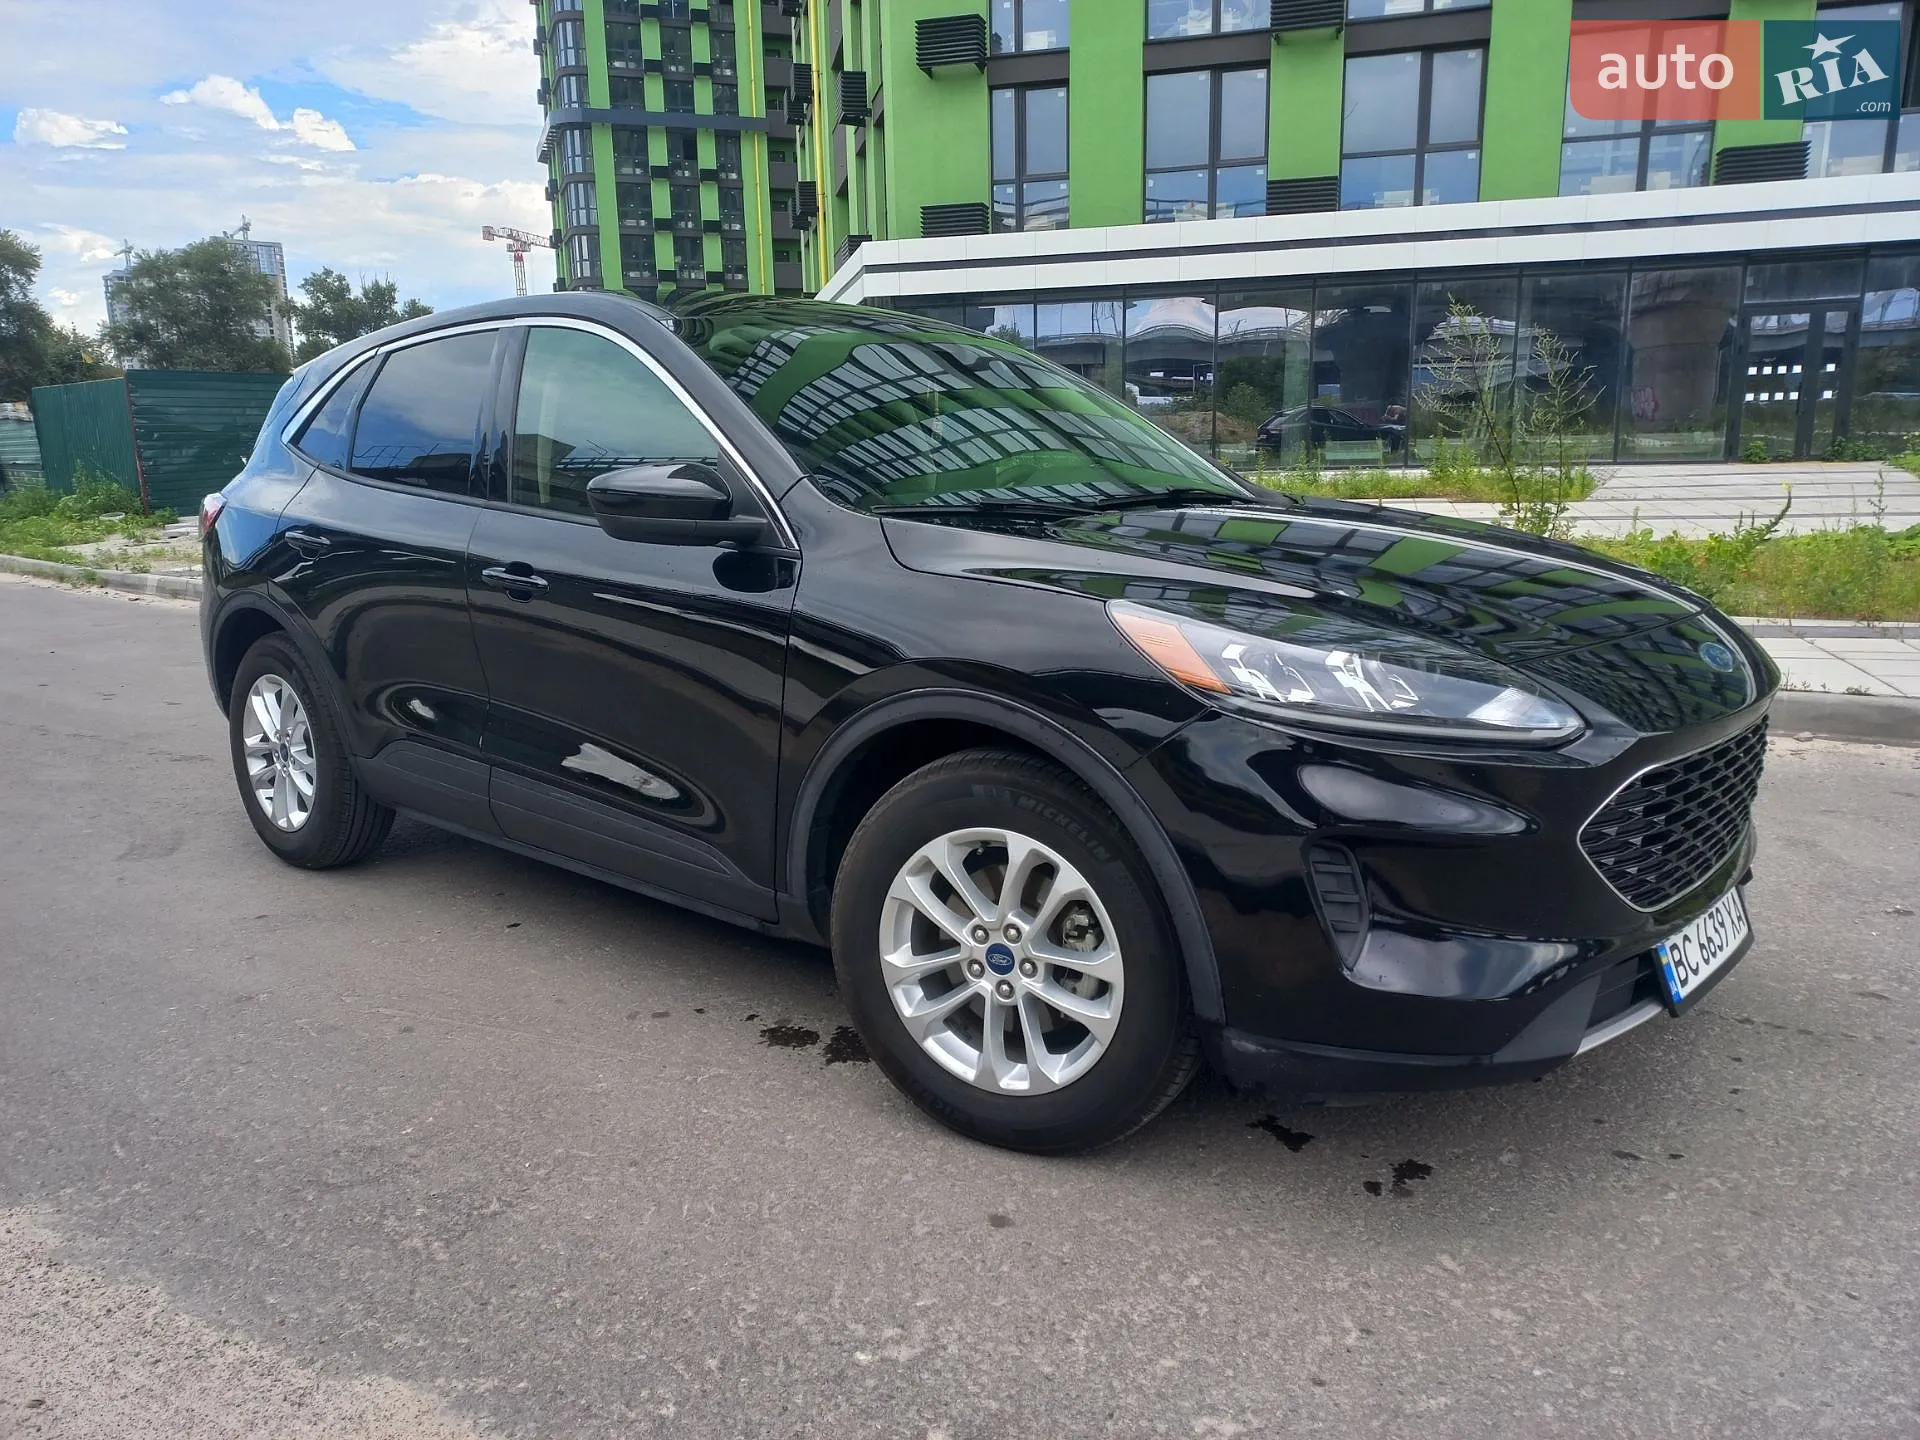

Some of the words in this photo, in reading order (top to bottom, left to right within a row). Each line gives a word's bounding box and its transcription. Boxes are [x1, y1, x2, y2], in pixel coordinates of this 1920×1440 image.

[1016, 796, 1112, 862] MICHELIN
[1669, 934, 1699, 988] BC
[1697, 907, 1729, 966] 6639
[1723, 892, 1746, 939] XA
